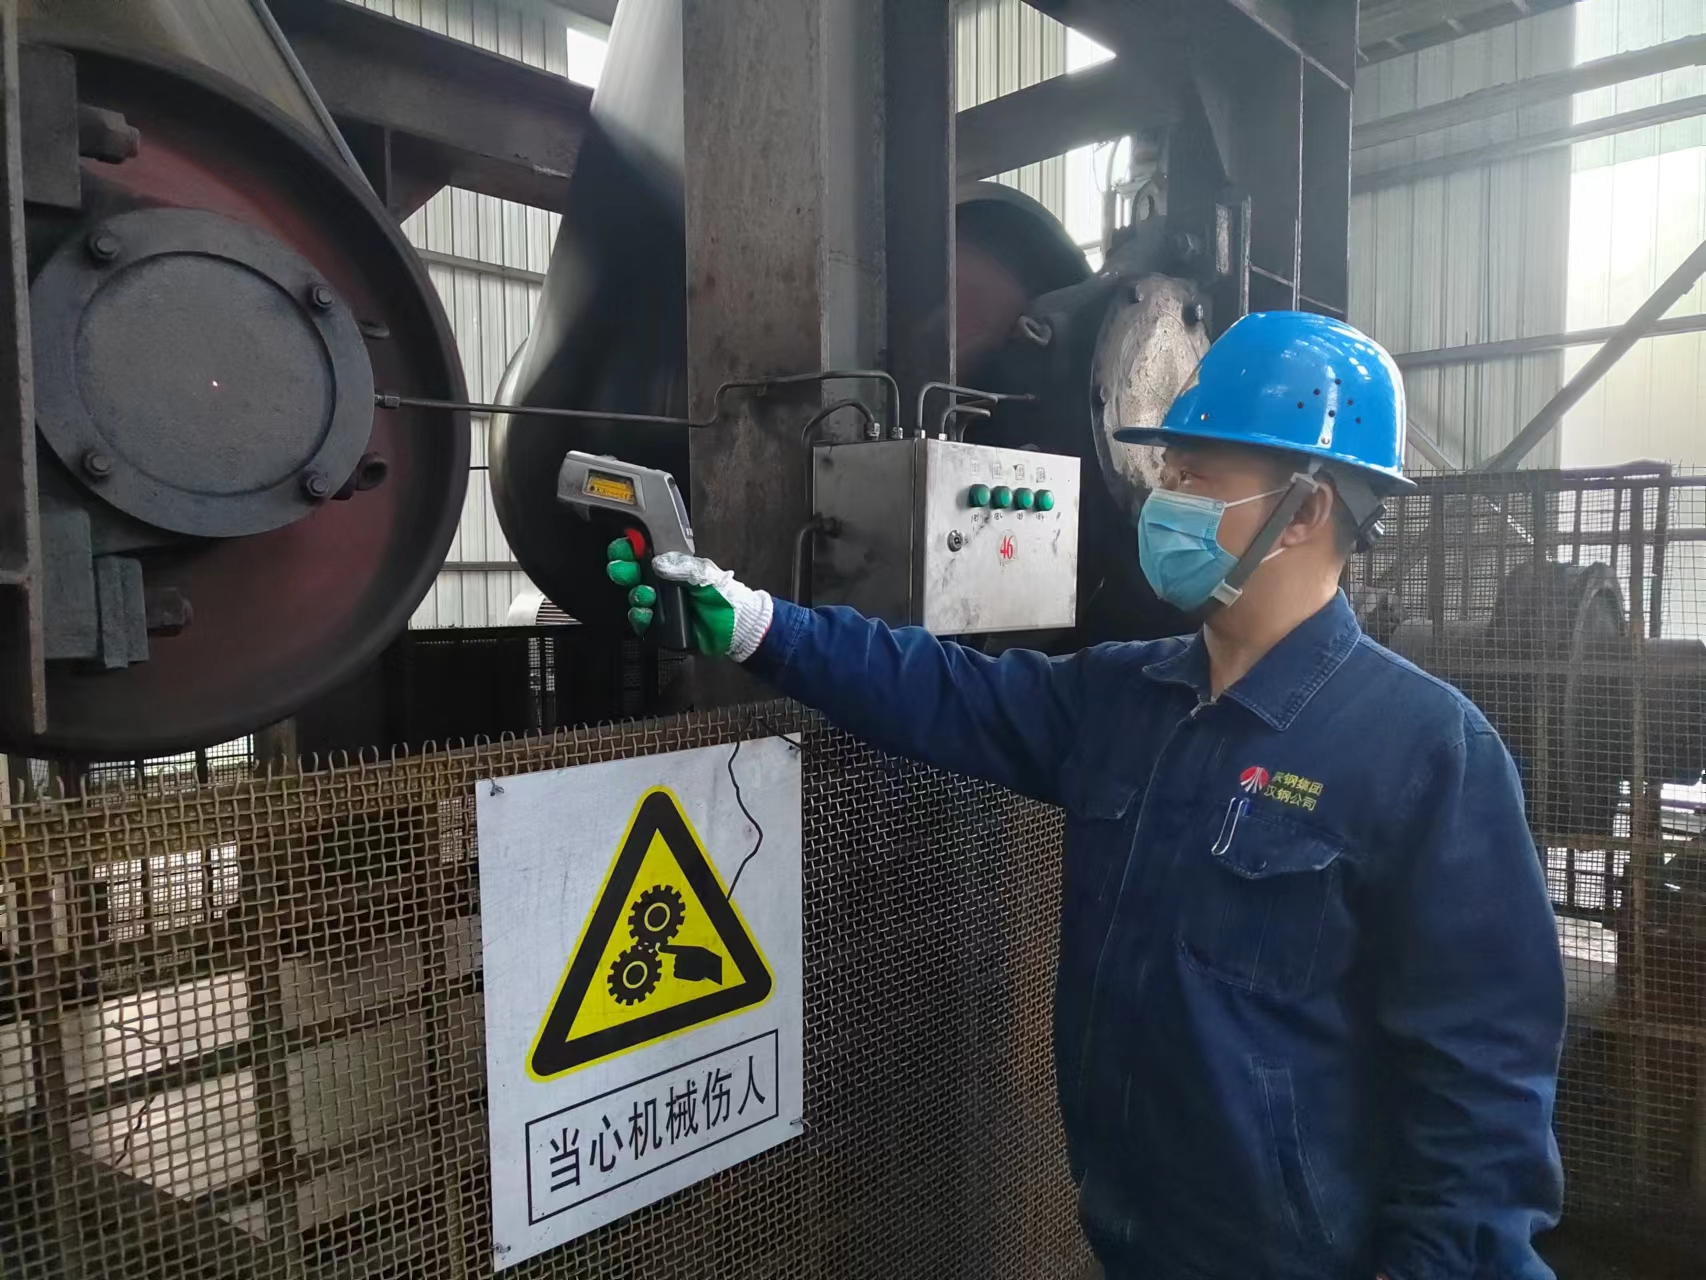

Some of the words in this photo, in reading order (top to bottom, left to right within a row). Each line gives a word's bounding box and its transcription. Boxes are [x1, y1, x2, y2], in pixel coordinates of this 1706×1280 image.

[1000, 535, 1014, 560] 46
[1263, 784, 1317, 811] 汉钢公司
[549, 1055, 766, 1193] 当心机械伤人
